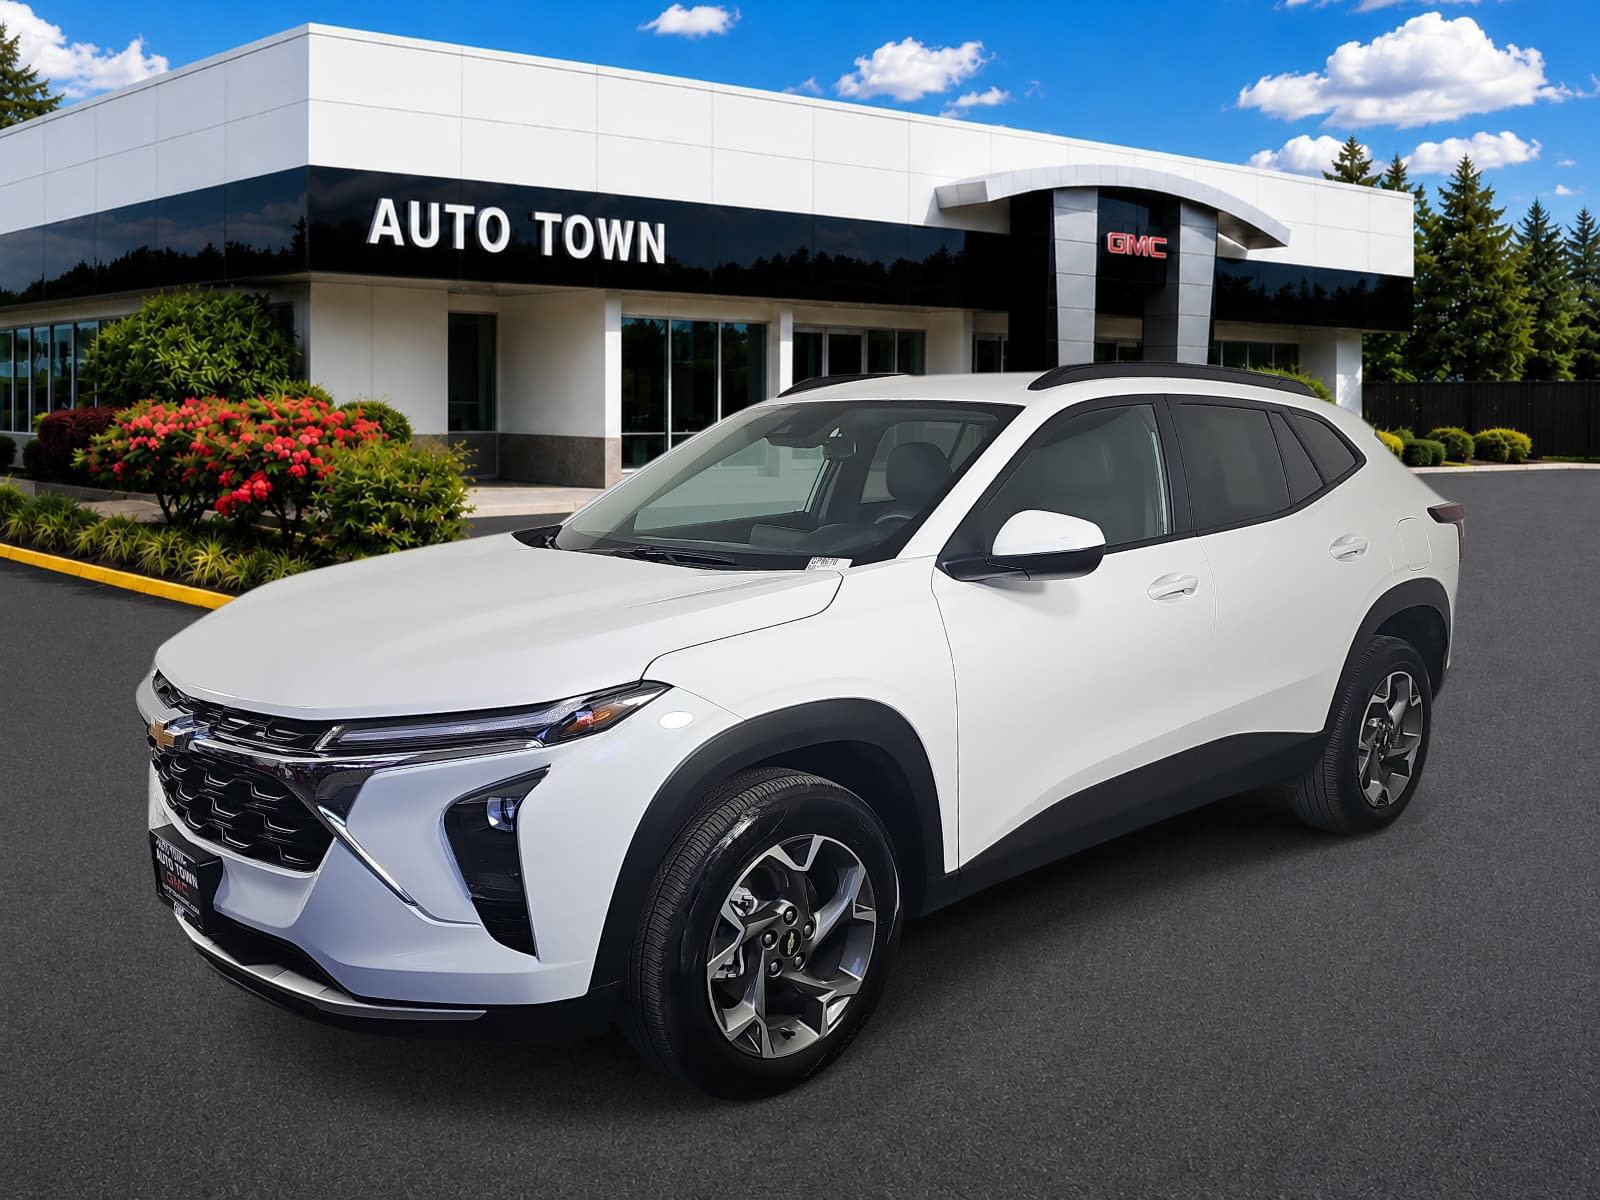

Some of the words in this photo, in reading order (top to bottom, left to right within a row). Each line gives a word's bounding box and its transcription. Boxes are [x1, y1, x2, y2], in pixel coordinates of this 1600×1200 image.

[366, 198, 511, 253] AUTO
[532, 211, 666, 265] TOWN
[1107, 232, 1168, 259] GMC
[156, 848, 174, 872] AUTO
[175, 862, 199, 889] TOWN
[166, 871, 189, 897] GMC
